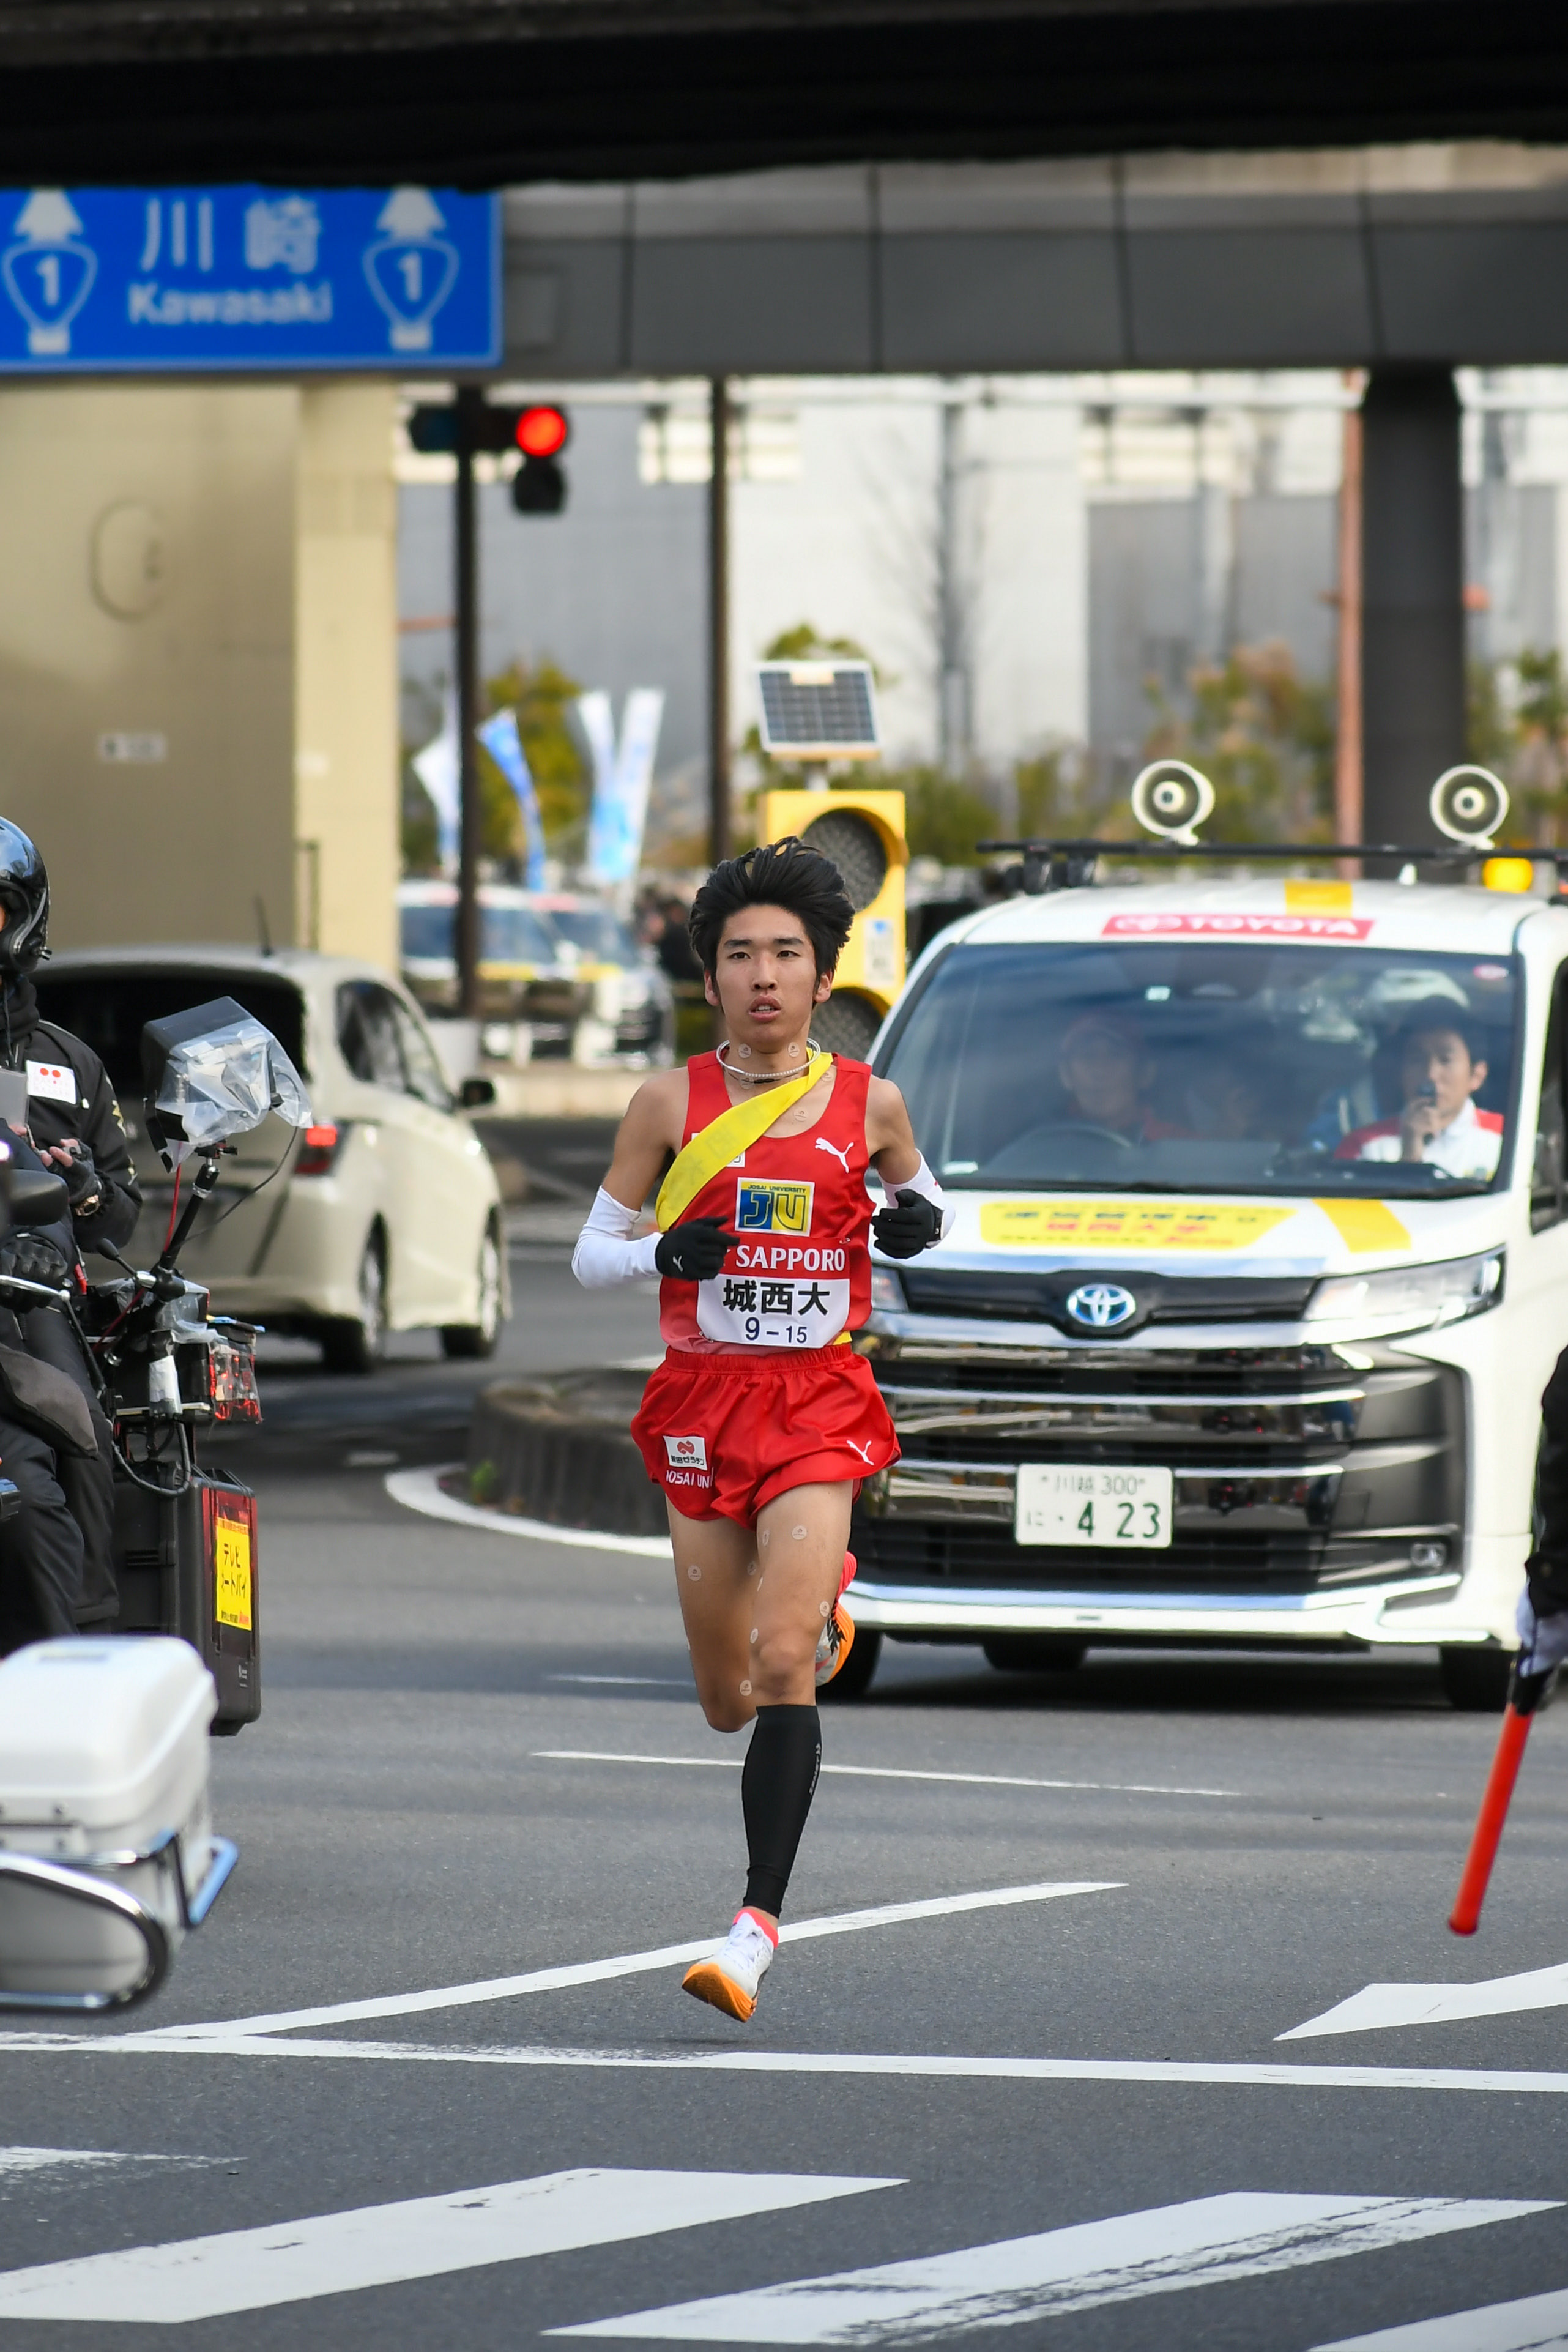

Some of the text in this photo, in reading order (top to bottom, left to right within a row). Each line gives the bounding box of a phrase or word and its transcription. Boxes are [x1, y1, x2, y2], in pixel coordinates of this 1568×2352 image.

[35, 253, 59, 307] 1
[397, 251, 423, 303] 1
[128, 280, 333, 325] Kawasaki
[1188, 914, 1359, 936] TOYOTA
[743, 1193, 806, 1231] JU
[735, 1245, 845, 1271] SAPPORO
[723, 1279, 830, 1316] 城西大
[1102, 1475, 1137, 1495] 300
[223, 1543, 241, 1568] テレビ
